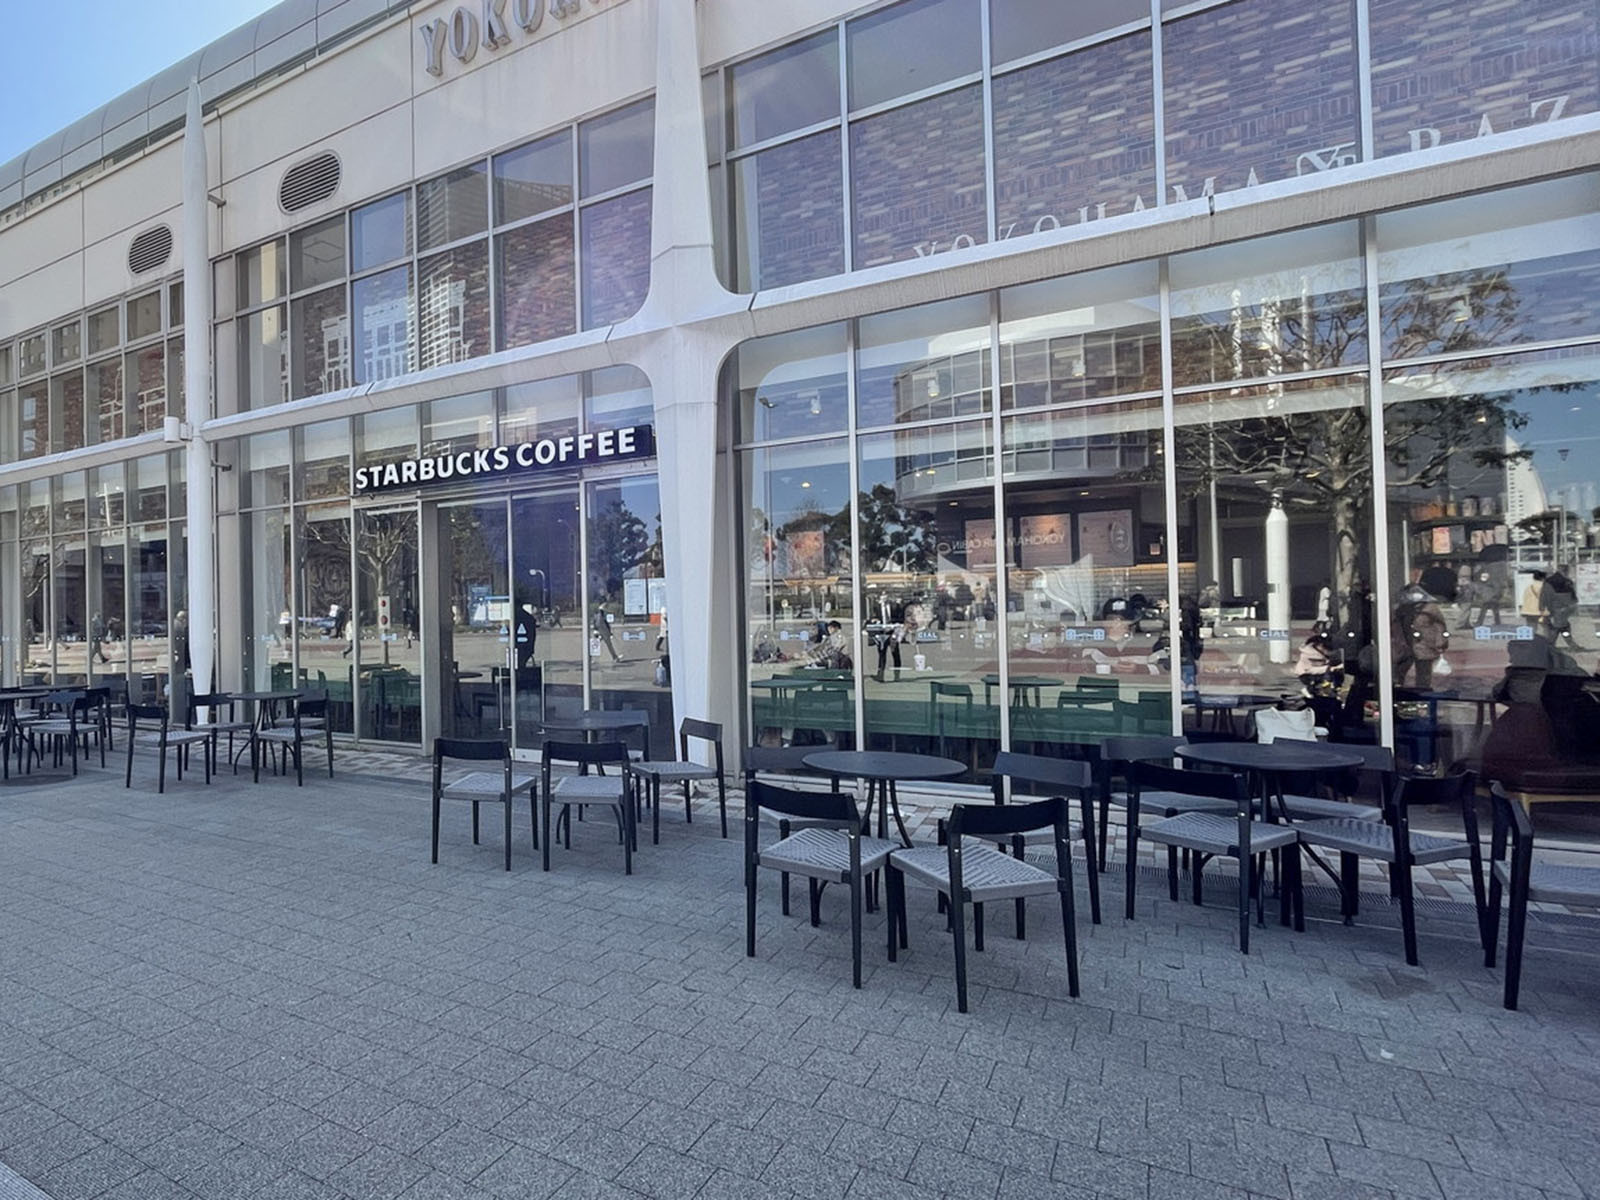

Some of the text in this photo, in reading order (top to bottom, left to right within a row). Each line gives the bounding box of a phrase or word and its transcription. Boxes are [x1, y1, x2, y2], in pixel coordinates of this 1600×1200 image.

[420, 0, 606, 77] YOKO
[355, 446, 509, 490] STARBUCKS
[515, 427, 636, 467] COFFEE
